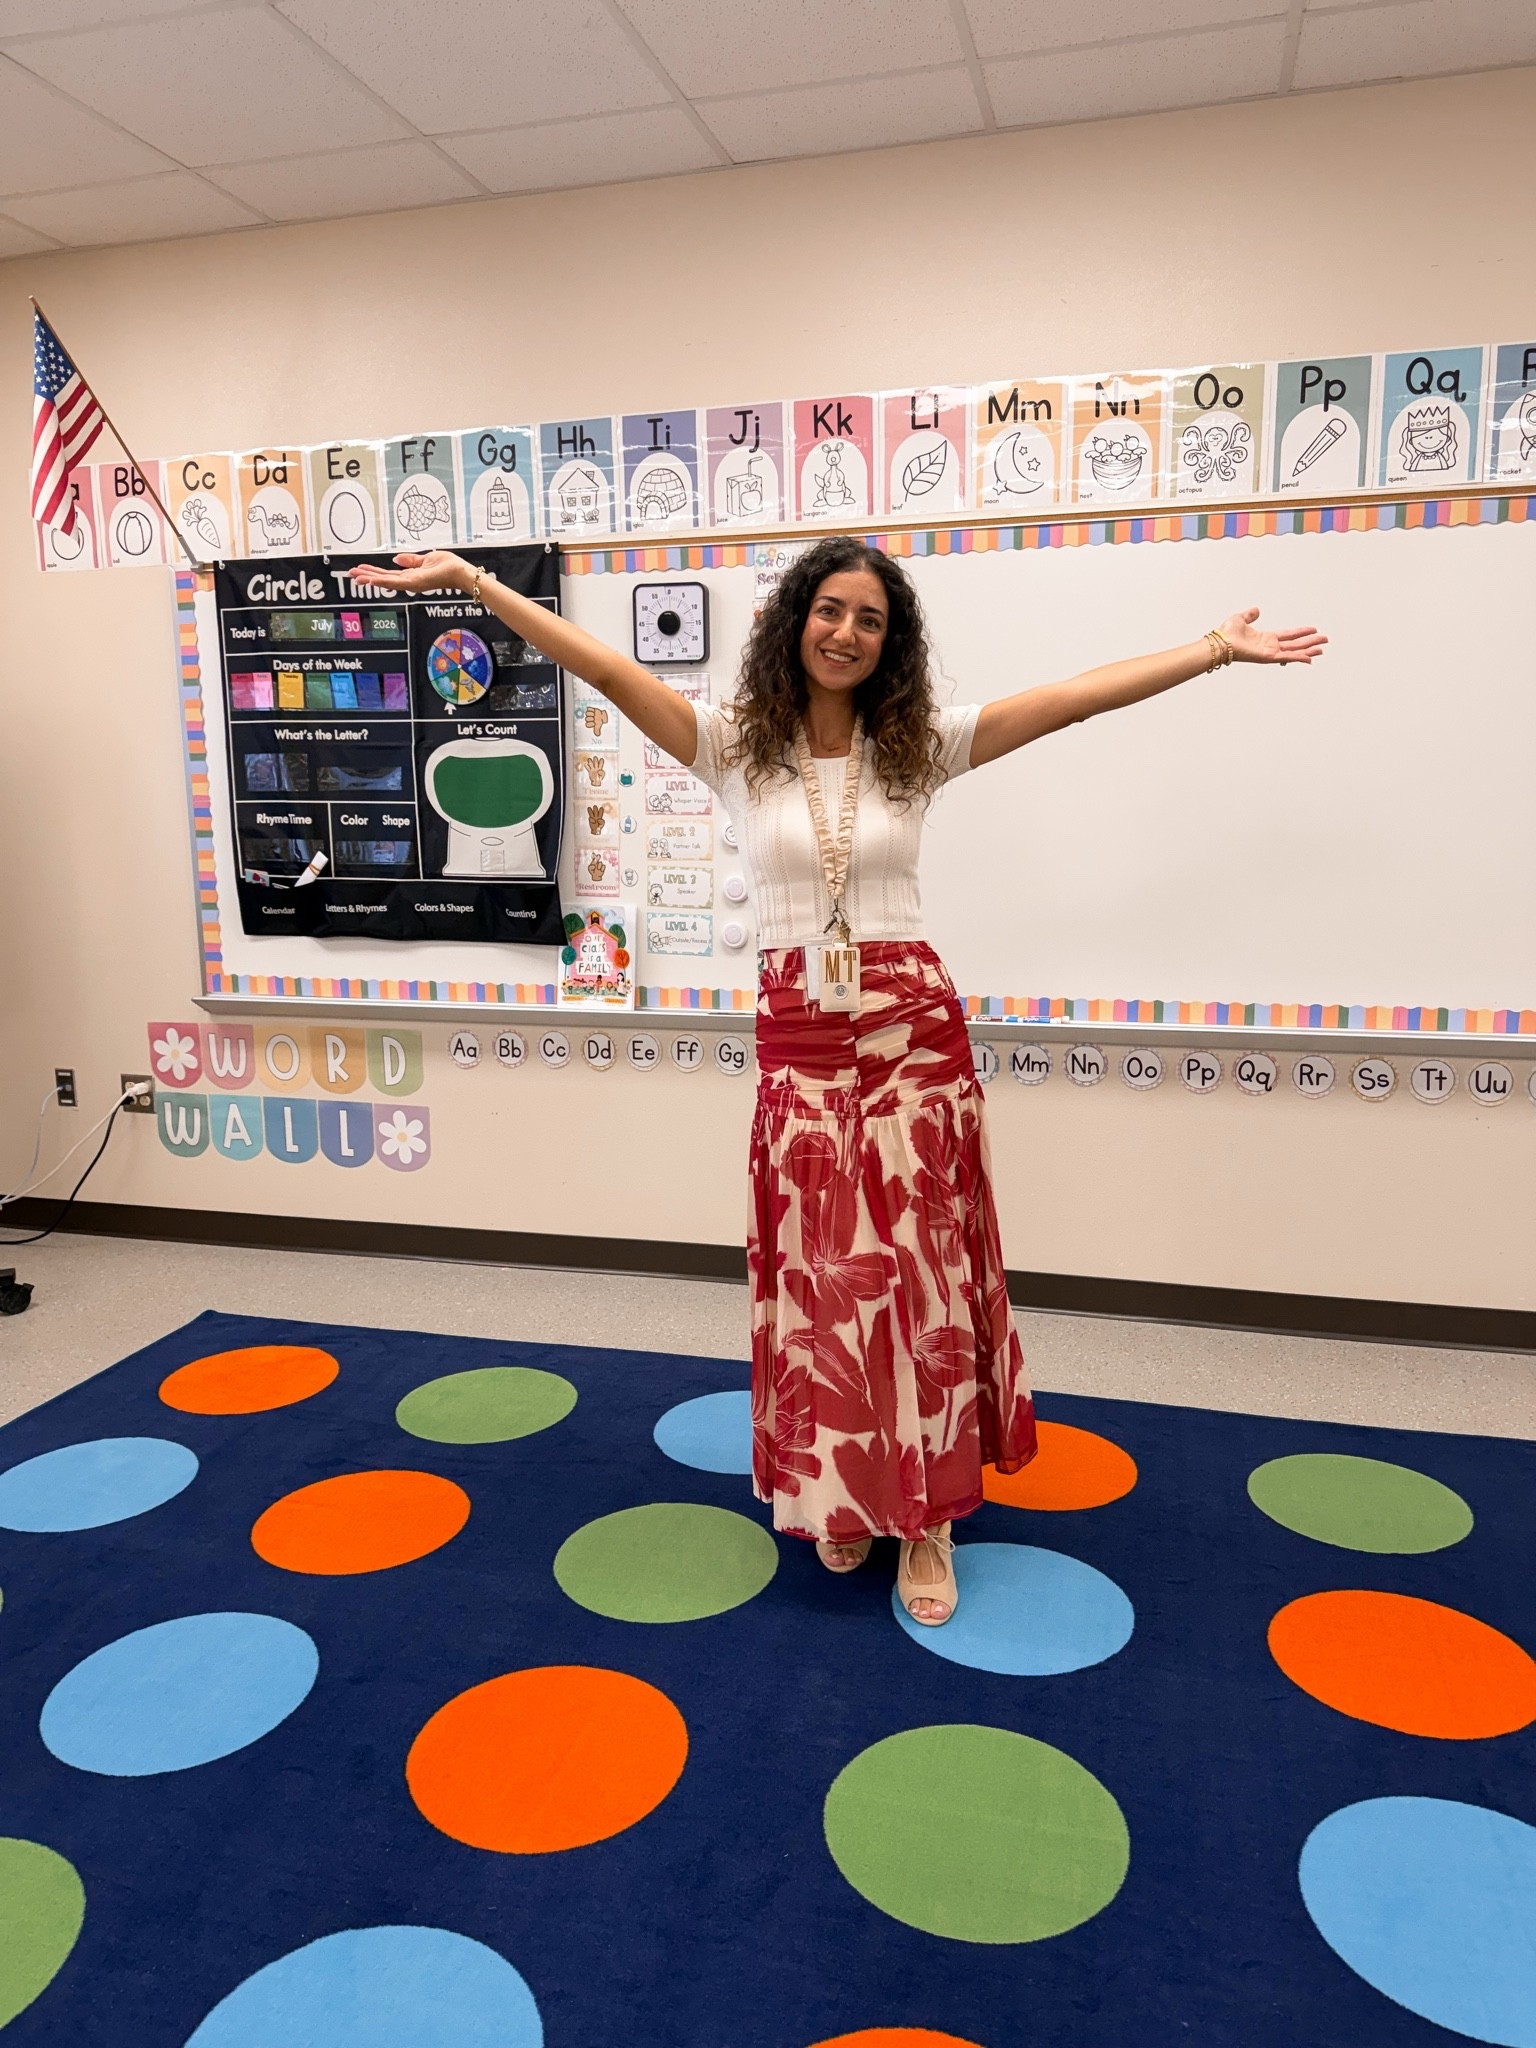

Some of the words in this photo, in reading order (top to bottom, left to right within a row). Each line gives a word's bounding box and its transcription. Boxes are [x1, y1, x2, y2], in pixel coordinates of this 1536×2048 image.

[1299, 365, 1347, 412] Pp
[1405, 356, 1466, 402] Qq
[1095, 381, 1140, 417] Nn
[1194, 373, 1243, 410] Oo
[911, 393, 939, 430] Ll
[988, 387, 1051, 424] Mm
[728, 409, 760, 453] Jj
[813, 402, 853, 438] Kk
[557, 424, 596, 459] Hh
[647, 418, 671, 452] Ii
[326, 447, 360, 480] Ee
[401, 438, 436, 473] Ff
[478, 433, 516, 473] Gg
[182, 460, 216, 491] Cc
[253, 452, 288, 486] Dd
[114, 466, 146, 497] Bb
[1281, 481, 1299, 489] pencil
[247, 570, 326, 601] Circle
[425, 606, 462, 617] What's
[465, 605, 482, 616] the
[230, 628, 256, 640] Today
[258, 627, 266, 638] is
[311, 620, 333, 633] July
[345, 621, 359, 632] 30
[373, 620, 397, 629] 2026
[273, 660, 300, 673] Days
[302, 659, 313, 670] of
[315, 659, 332, 670] the
[333, 658, 363, 670] Week
[274, 729, 313, 740] What's
[315, 729, 332, 740] the
[334, 729, 368, 740] Letter?
[457, 724, 482, 736] Let's
[485, 724, 518, 735] Count
[666, 781, 689, 791] LEVEL
[340, 815, 368, 826] Color
[382, 814, 410, 828] Shape
[663, 827, 686, 837] LEVEL
[690, 827, 695, 837] 2
[664, 874, 687, 884] LEVEL
[691, 874, 696, 884] 3
[348, 905, 355, 913] &
[355, 904, 388, 914] Rhymes
[414, 903, 439, 912] Colors
[440, 904, 446, 912] &
[446, 903, 474, 914] Shapes
[505, 908, 537, 919] Counting
[665, 921, 688, 931] LEVEL
[691, 921, 697, 931] 4
[579, 963, 612, 974] FAMILY
[825, 950, 857, 983] MT
[453, 1037, 477, 1059] Aa
[499, 1038, 522, 1058] Bb
[542, 1038, 566, 1058] Cc
[587, 1038, 611, 1060] Dd
[632, 1039, 656, 1061] Ee
[676, 1040, 699, 1062] Ff
[718, 1041, 745, 1069] Gg
[208, 1033, 406, 1086] WORD
[1012, 1052, 1049, 1073] Mm
[1071, 1053, 1100, 1075] Nn
[1127, 1057, 1158, 1079] Oo
[1187, 1058, 1215, 1086] Pp
[1238, 1060, 1272, 1092] Qq
[1299, 1063, 1328, 1086] Rr
[1358, 1067, 1390, 1091] Ss
[1420, 1068, 1447, 1091] Tt
[1475, 1070, 1507, 1094] Uu
[164, 1102, 354, 1157] WALL
